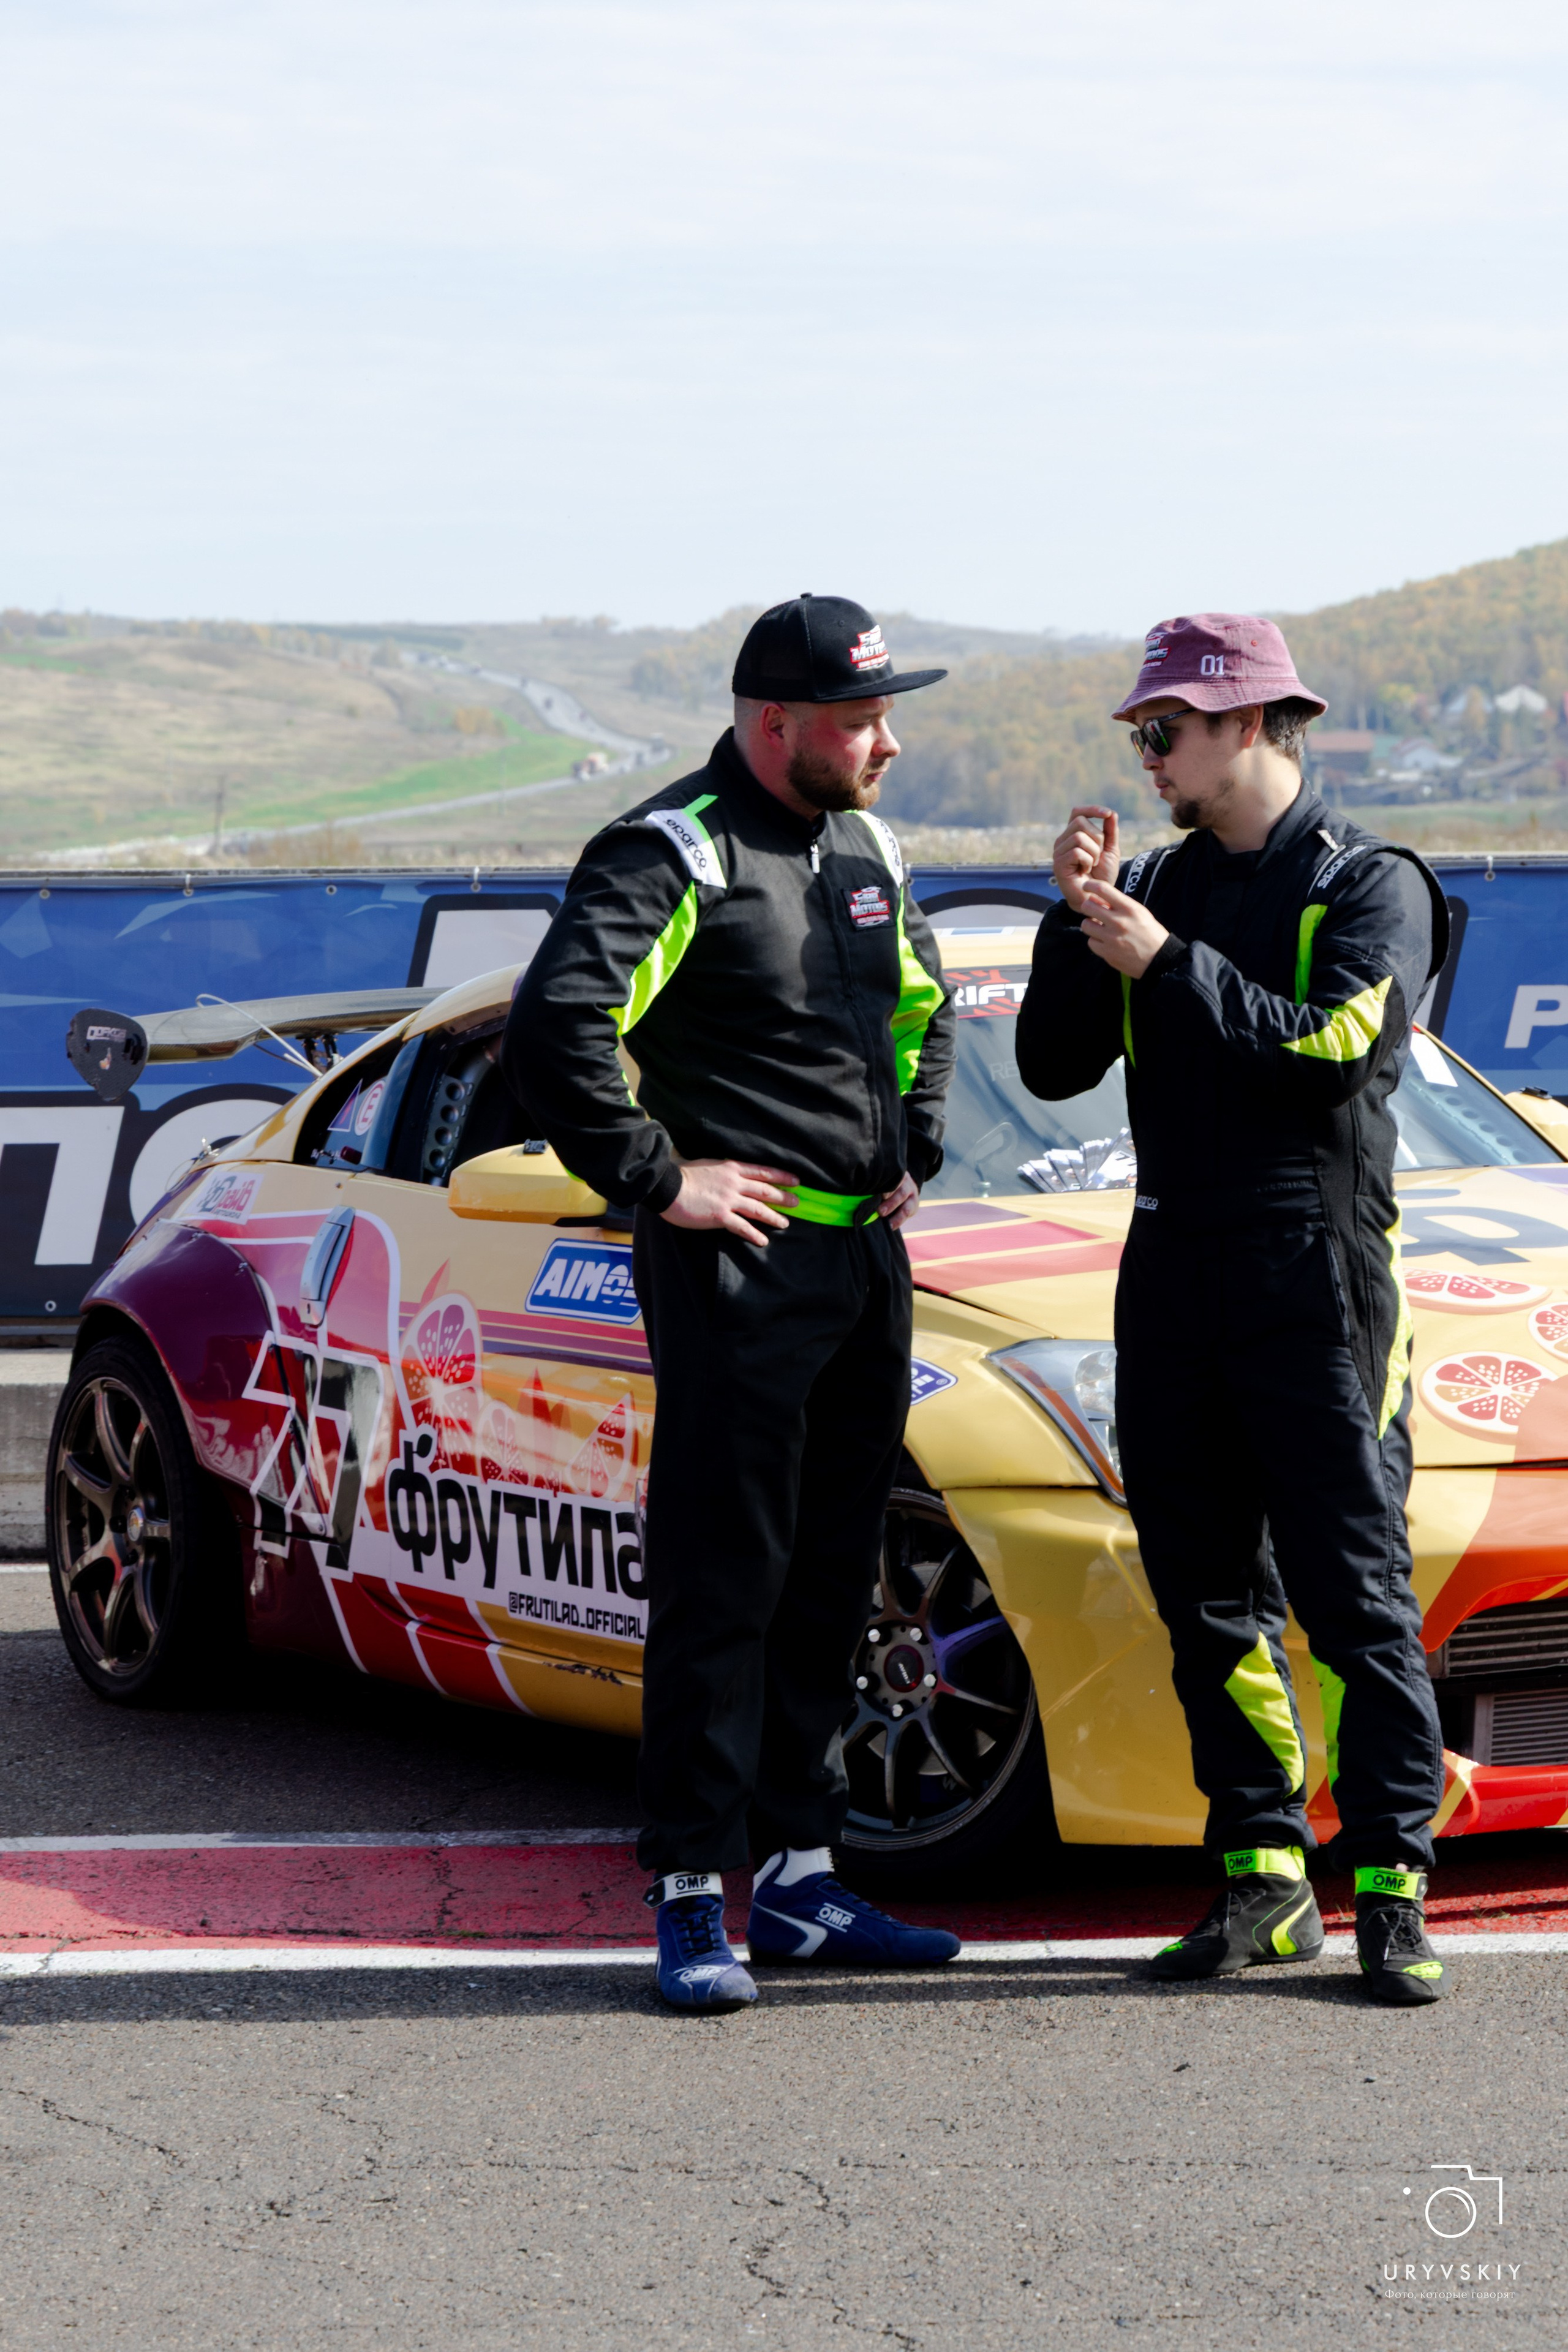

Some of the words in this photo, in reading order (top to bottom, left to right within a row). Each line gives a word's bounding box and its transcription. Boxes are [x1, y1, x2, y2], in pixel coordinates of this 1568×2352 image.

[1200, 655, 1225, 676] 01
[509, 1591, 645, 1640] @FRUTILAD_OFFICIAL
[1228, 1856, 1253, 1869] OMP
[676, 1875, 709, 1890] OMP
[1373, 1874, 1406, 1890] OMP
[819, 1907, 853, 1928] OMP
[679, 1968, 722, 1980] OMP
